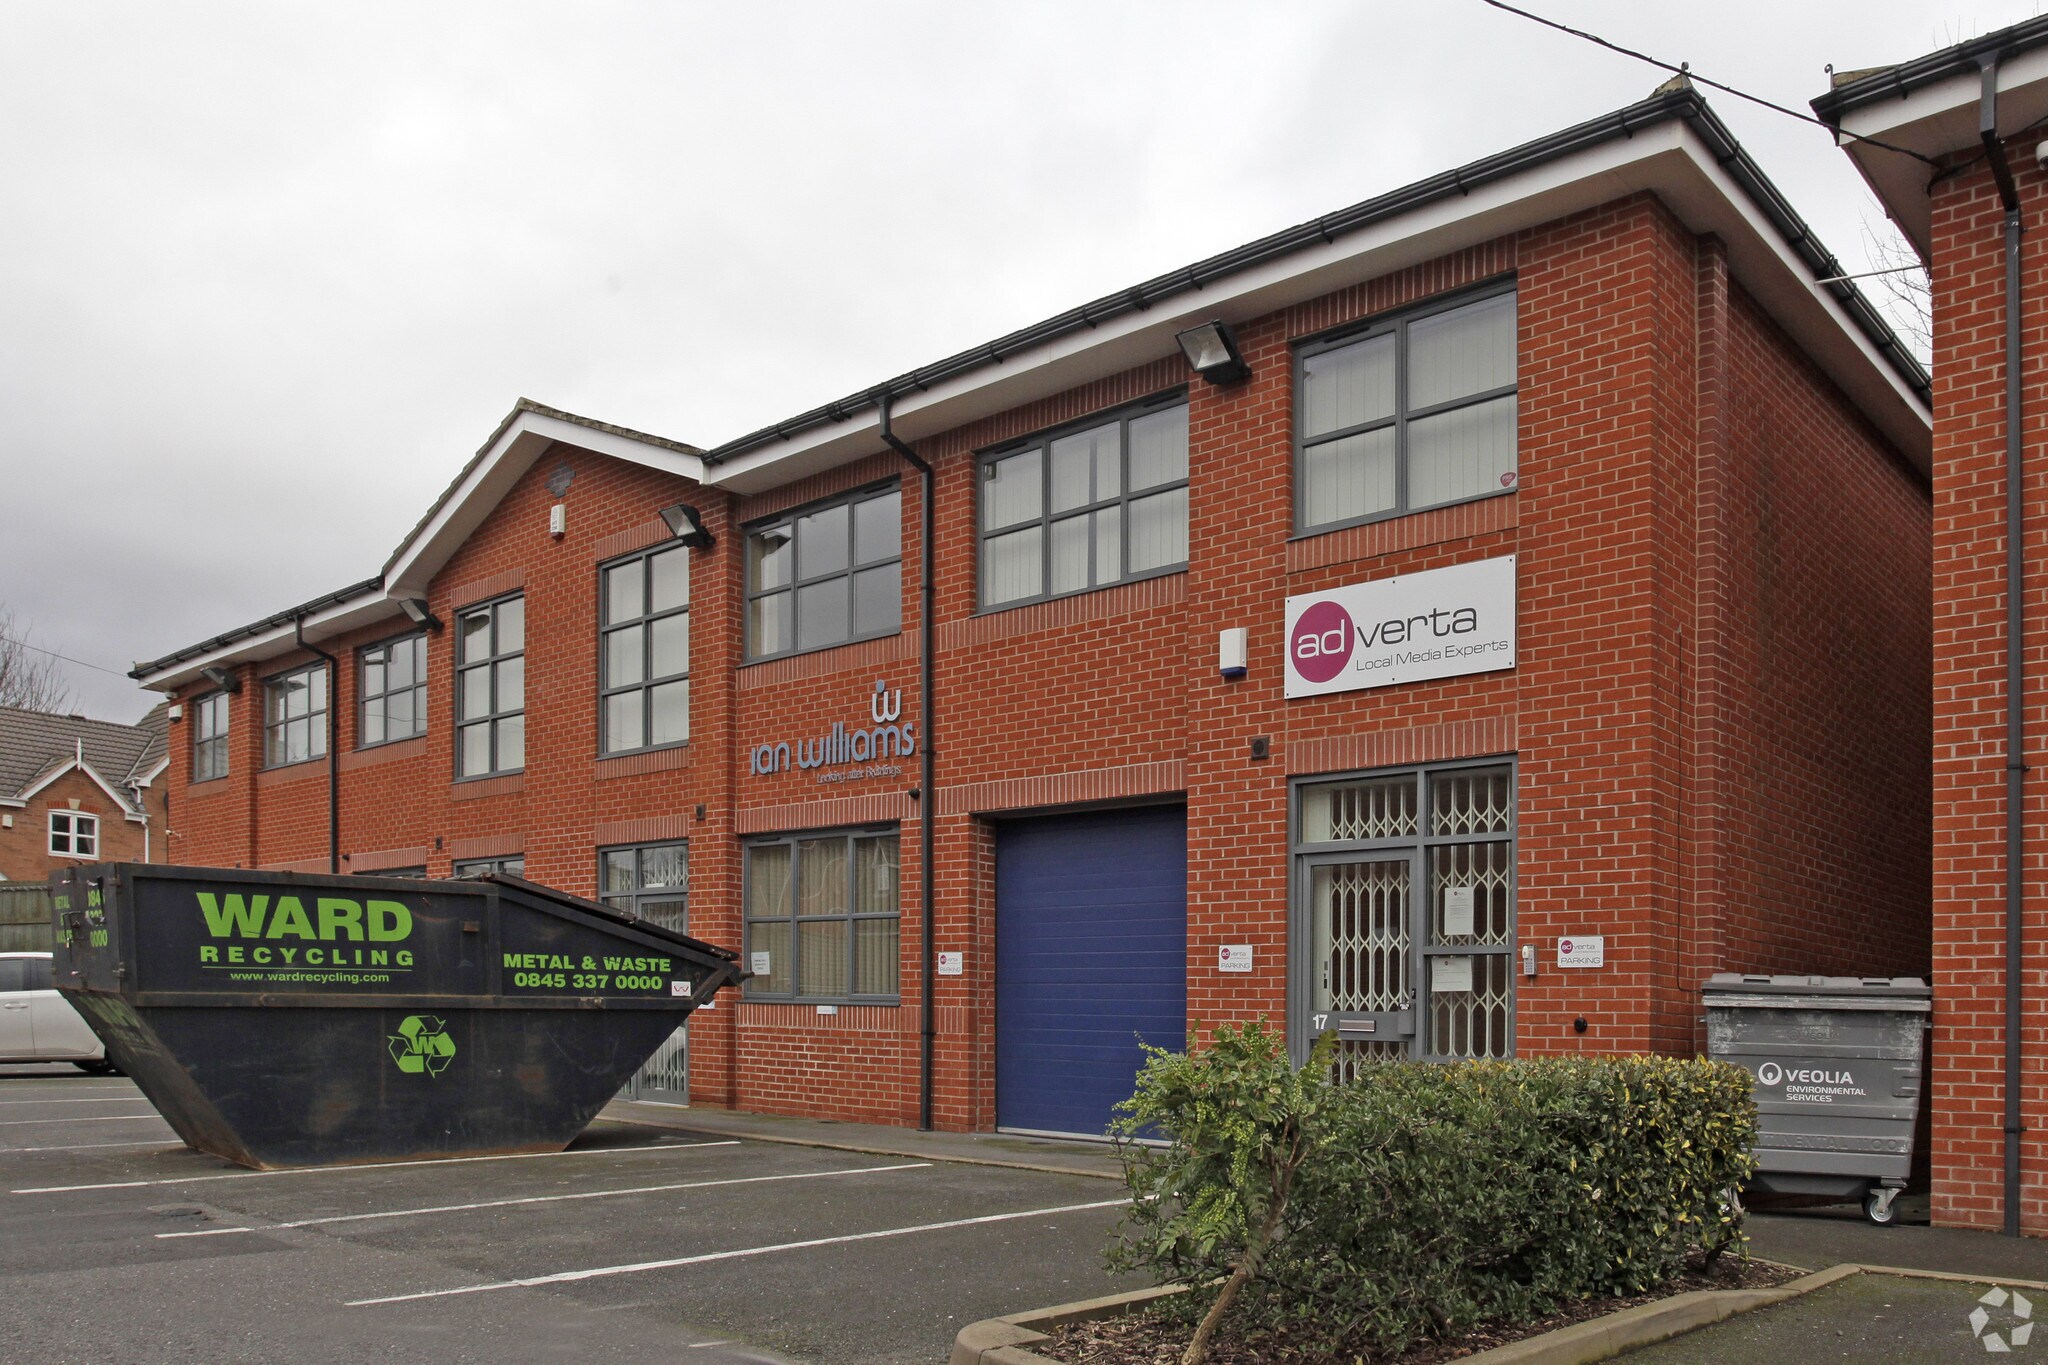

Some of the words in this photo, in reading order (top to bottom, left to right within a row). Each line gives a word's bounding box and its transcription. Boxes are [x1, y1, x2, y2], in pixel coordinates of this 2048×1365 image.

[1356, 653, 1393, 671] Local
[1397, 648, 1441, 666] Media
[1445, 640, 1509, 659] Experts
[798, 721, 915, 770] williams
[196, 892, 413, 942] WARD
[200, 945, 413, 967] RECYCLING
[503, 953, 575, 970] METAL
[581, 956, 597, 971] &
[603, 956, 671, 973] WASTE
[230, 972, 389, 985] www.wardrecycling.com
[514, 972, 566, 988] 0845
[573, 973, 608, 989] 337
[615, 975, 663, 990] 0000
[1312, 1014, 1328, 1030] 17
[1785, 1070, 1854, 1084] VEOLIA
[1786, 1085, 1866, 1096] ENVIRONMENTAL
[1786, 1093, 1833, 1103] SERVICES
